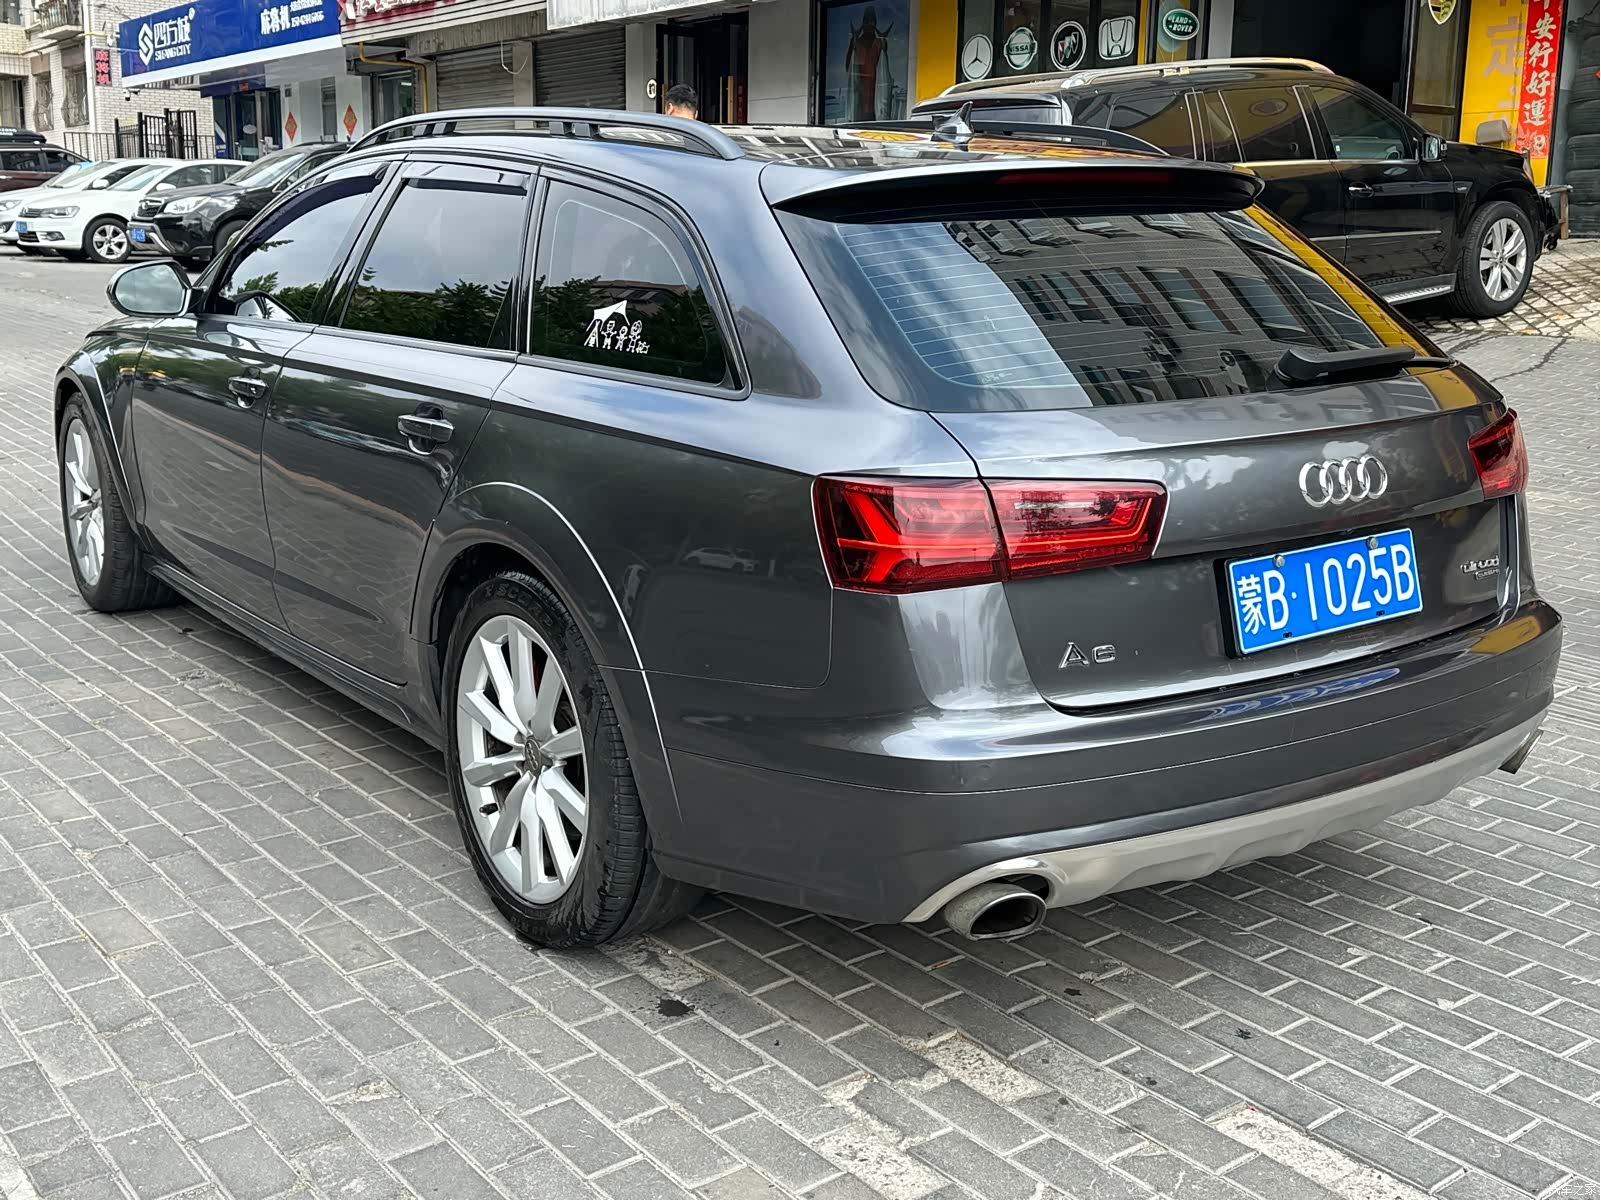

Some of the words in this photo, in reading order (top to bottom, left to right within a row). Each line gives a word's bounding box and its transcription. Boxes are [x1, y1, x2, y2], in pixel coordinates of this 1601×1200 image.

[153, 15, 191, 48] 四方城
[260, 5, 291, 35] 麻将机
[1171, 16, 1189, 24] LAND
[1172, 24, 1193, 33] ROVER
[1237, 543, 1416, 635] 蒙B·1025B
[1058, 641, 1117, 669] A6
